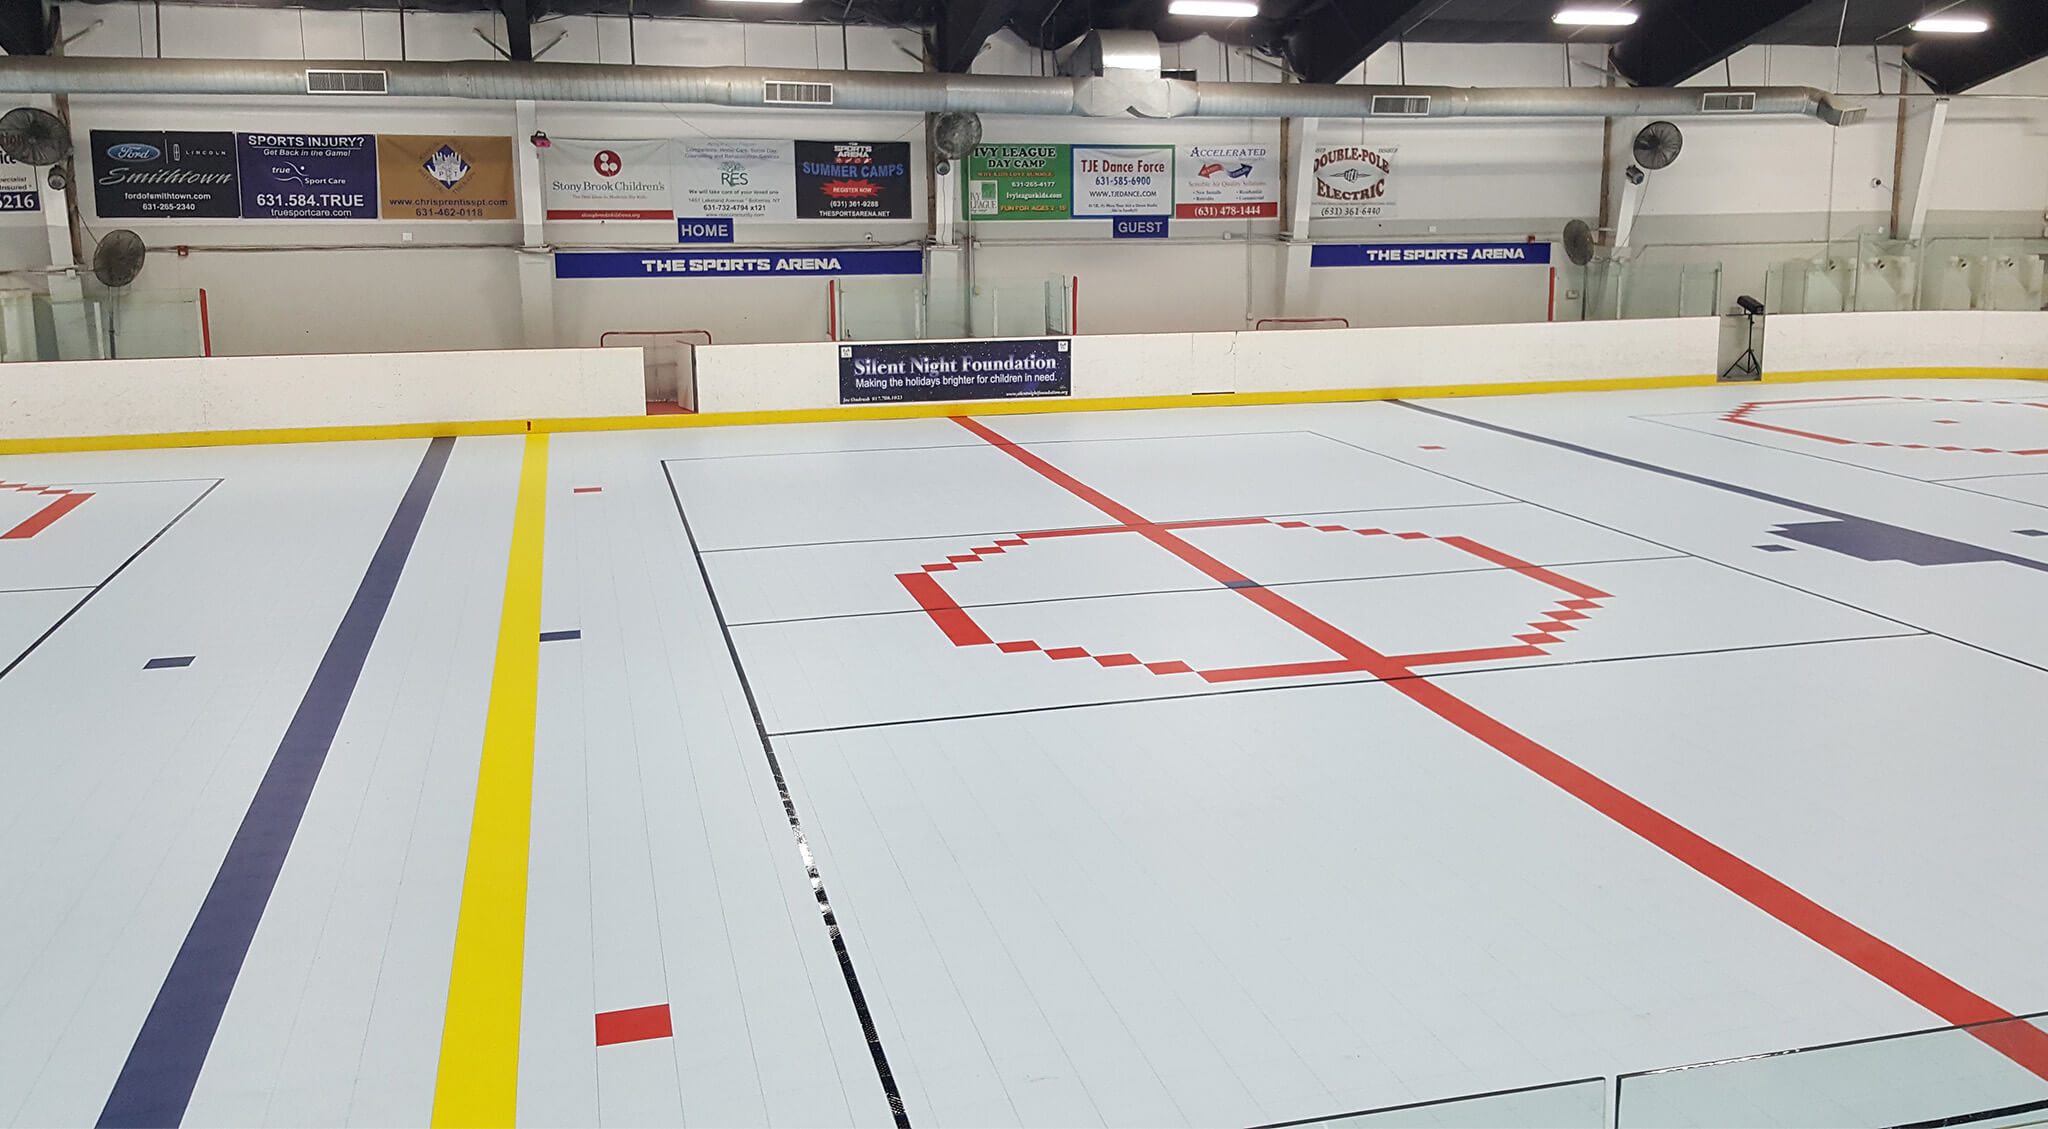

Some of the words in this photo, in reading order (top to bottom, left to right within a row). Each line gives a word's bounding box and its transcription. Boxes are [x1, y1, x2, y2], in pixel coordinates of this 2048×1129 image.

[248, 135, 304, 147] SPORTS
[308, 137, 365, 147] INJURY?
[117, 146, 150, 159] Ford
[974, 147, 998, 157] IVY
[1002, 147, 1056, 157] LEAGUE
[1190, 146, 1266, 157] ACCELERATED
[988, 159, 1011, 168] DAY
[1014, 159, 1046, 168] CAMP
[1081, 160, 1099, 172] TJE
[1102, 160, 1134, 172] Dance
[1138, 160, 1165, 172] Force
[803, 162, 858, 178] SUMMER
[861, 163, 904, 178] CAMPS
[99, 167, 232, 185] Smithtown
[304, 177, 326, 185] Sport
[721, 172, 749, 187] RES
[1095, 176, 1151, 185] 631-585-6900
[552, 181, 581, 193] Stony
[583, 181, 613, 191] Brook
[615, 181, 665, 191] Children's
[1316, 176, 1385, 200] ELECTRIC
[124, 192, 211, 200] fordofsmithtown.com
[256, 194, 364, 206] 631.584.TRUE
[390, 199, 508, 207] www.chrisprentisspt.com
[830, 200, 848, 208] (631)
[970, 200, 997, 208] LEAGUE
[271, 208, 352, 217] truesportcare.com
[416, 208, 483, 217] 631-462-0118
[1194, 206, 1218, 216] (631)
[1219, 205, 1260, 216] 478-1444
[1320, 207, 1342, 217] (631)
[681, 224, 728, 237] HOME
[1118, 222, 1163, 233] GUEST
[1367, 250, 1401, 261] THE
[1403, 249, 1468, 260] SPORTS
[1471, 248, 1525, 259] ARENA
[642, 259, 685, 272] THE
[689, 258, 771, 272] SPORTS
[775, 257, 841, 271] ARENA
[854, 358, 906, 376] Silent
[910, 356, 958, 378] Night
[962, 353, 1057, 372] Foundation
[856, 378, 887, 389] Making
[889, 377, 903, 387] the
[905, 376, 940, 388] holidays
[943, 374, 975, 387] brighter
[977, 374, 988, 384] for
[990, 373, 1022, 383] children
[1025, 373, 1032, 382] in
[1034, 372, 1057, 382] need.
